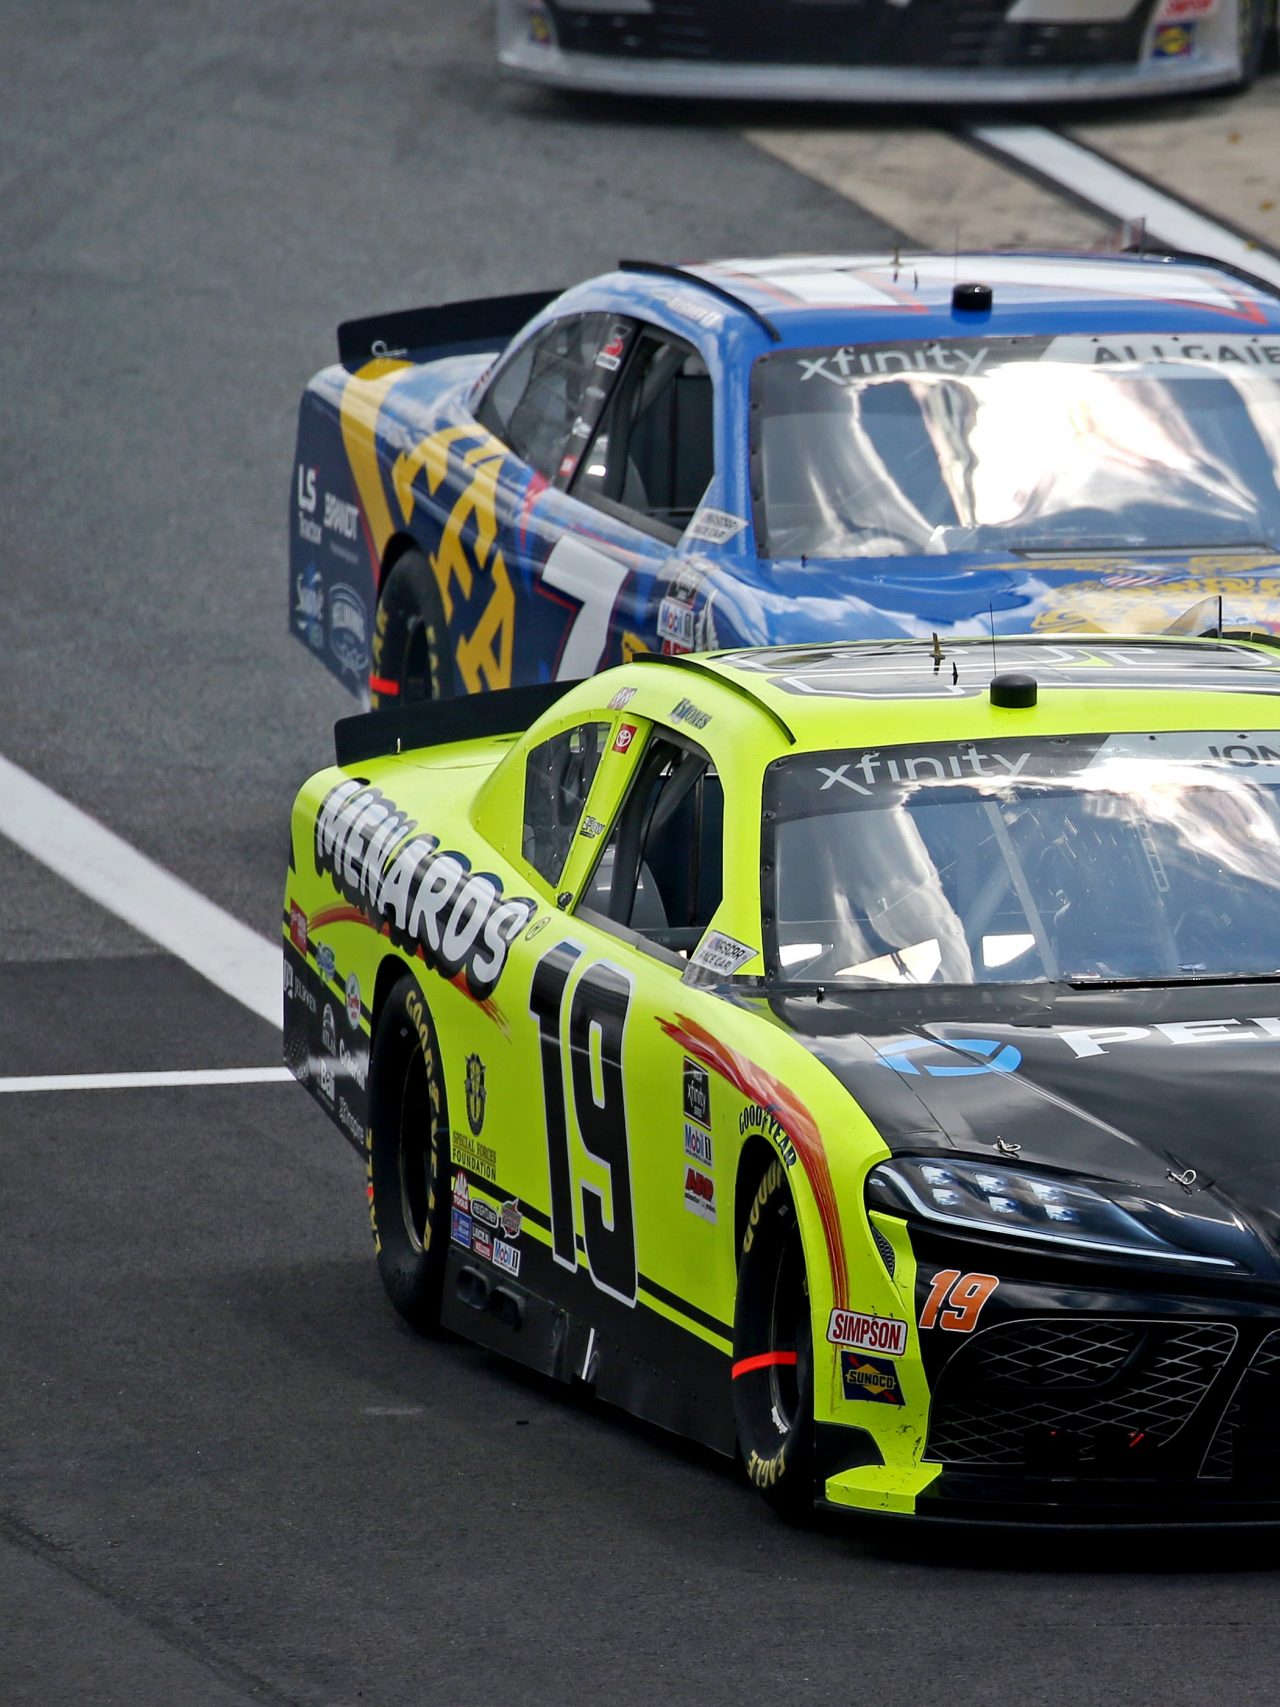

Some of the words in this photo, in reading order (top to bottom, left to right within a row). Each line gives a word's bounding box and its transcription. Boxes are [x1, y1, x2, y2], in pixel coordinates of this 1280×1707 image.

[799, 343, 989, 386] xfinity
[298, 463, 317, 513] LS
[540, 535, 630, 684] 7
[817, 749, 1032, 796] xfinity
[316, 779, 537, 990] MENARDS
[452, 1131, 475, 1153] SPECIAL
[529, 938, 638, 1308] 19
[685, 1124, 704, 1157] Mobil
[452, 1148, 497, 1183] FOUNDATION
[918, 1269, 1000, 1333] 19
[831, 1313, 901, 1352] SIMPSON
[847, 1368, 896, 1390] SUNOCO
